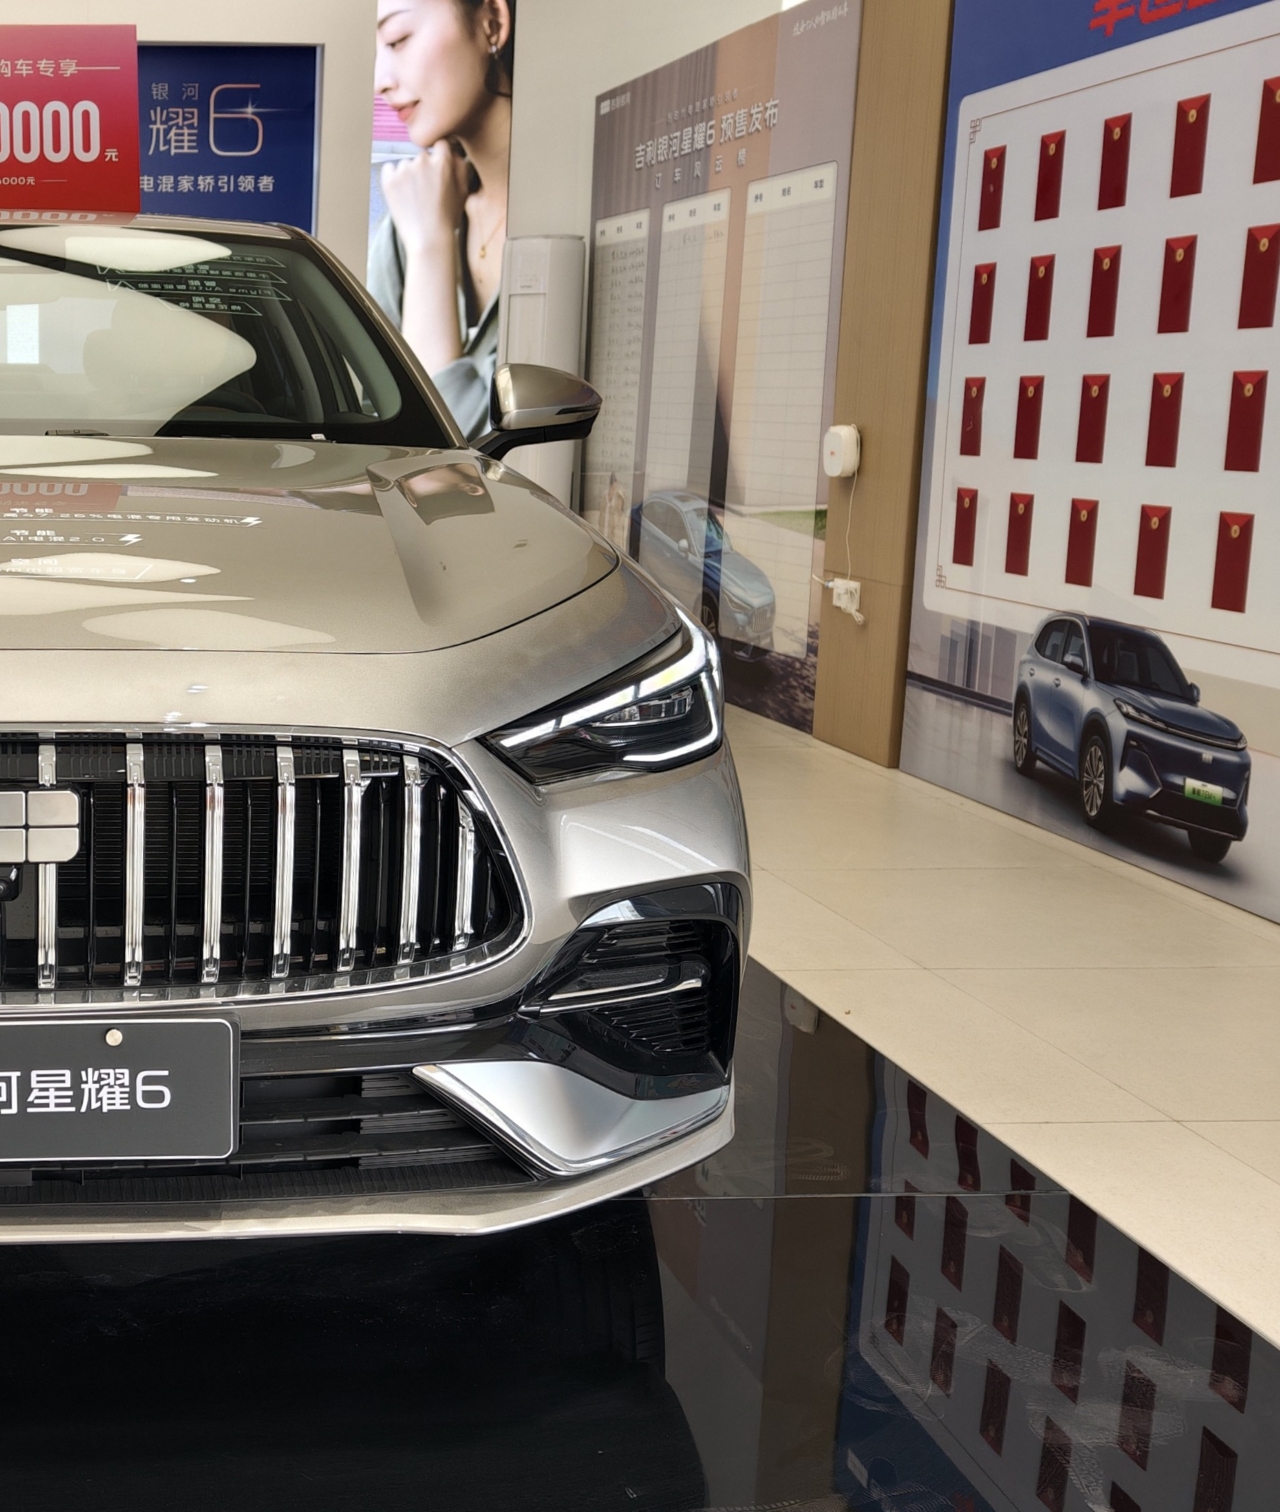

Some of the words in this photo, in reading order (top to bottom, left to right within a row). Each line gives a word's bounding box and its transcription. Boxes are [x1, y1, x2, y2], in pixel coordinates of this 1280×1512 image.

[151, 82, 199, 100] 银河
[634, 119, 716, 170] 吉利银河星耀6
[720, 98, 780, 143] 预售发布
[140, 175, 275, 193] 电混家轿引领者
